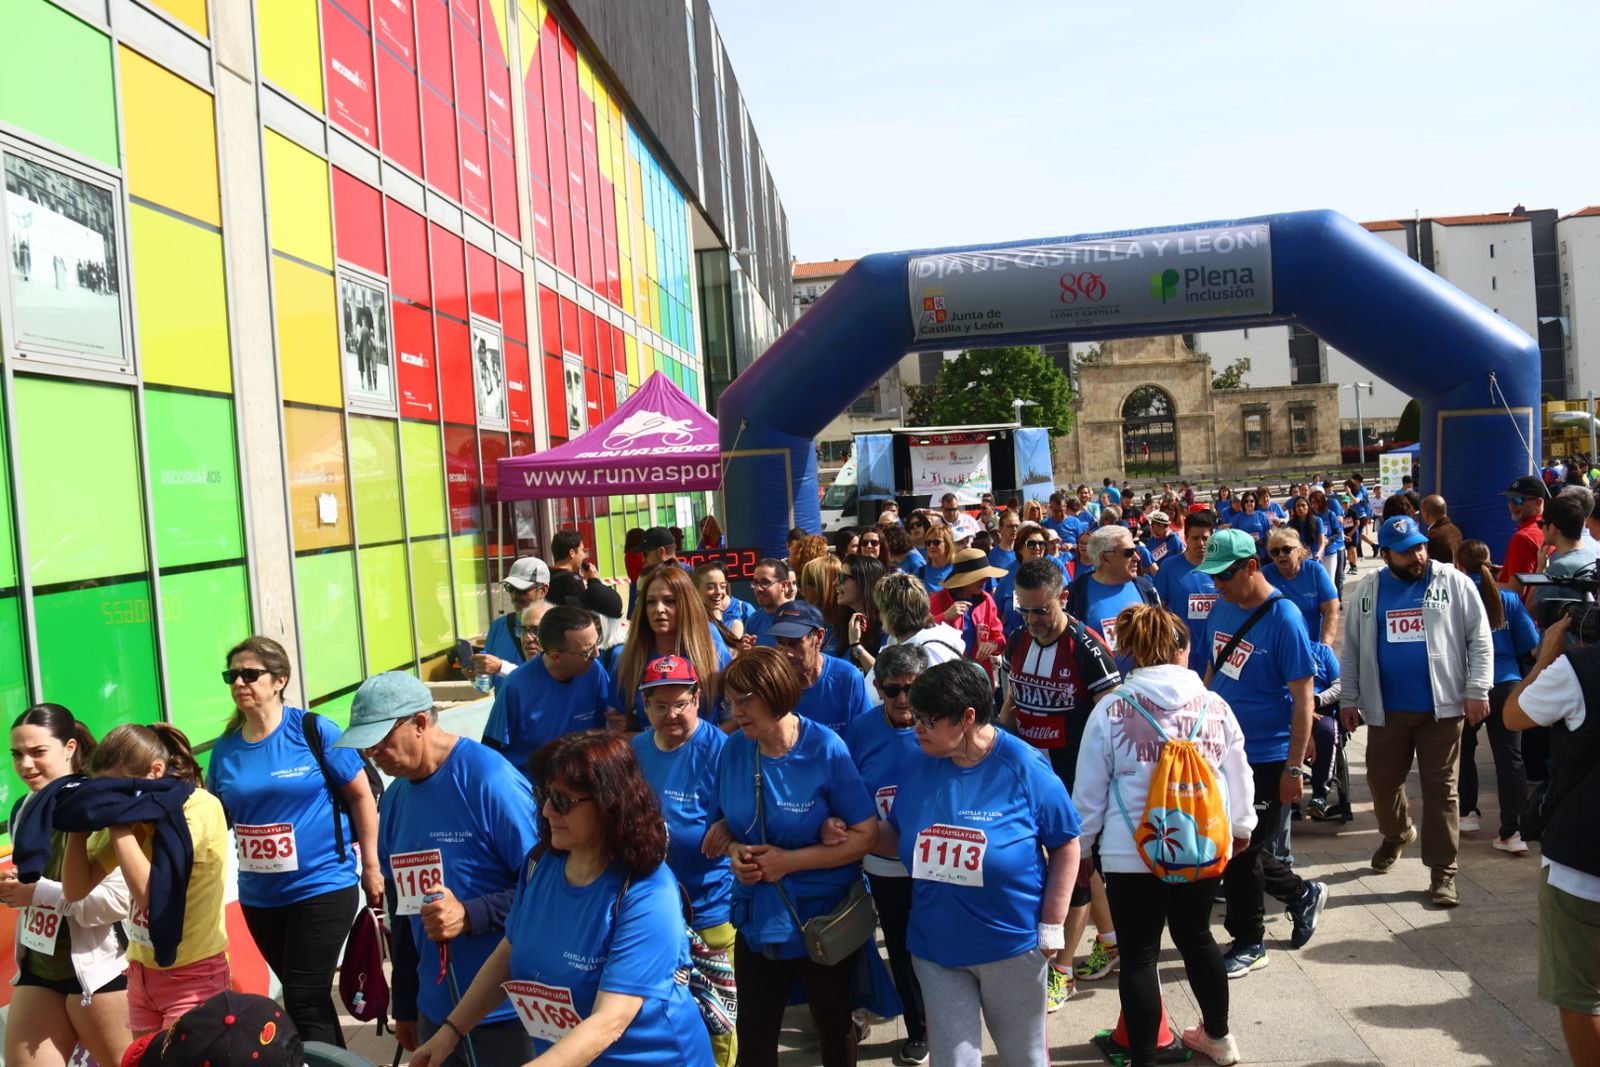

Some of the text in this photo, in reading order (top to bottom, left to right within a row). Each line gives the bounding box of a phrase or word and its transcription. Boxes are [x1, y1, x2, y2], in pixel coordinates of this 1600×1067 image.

[972, 254, 1008, 273] DE
[1015, 241, 1145, 269] CASTILLA
[1151, 238, 1170, 257] Y
[1178, 230, 1258, 255] LEÓN
[1184, 265, 1255, 288] Plena
[1184, 285, 1255, 303] inclusión
[951, 309, 1002, 321] Junta de
[921, 320, 1004, 334] Castilla y León
[1190, 601, 1212, 613] 109
[1389, 618, 1425, 634] 104
[1010, 671, 1070, 689] UNNING
[941, 829, 965, 838] CASTILLA
[240, 836, 293, 860] 1293
[919, 838, 982, 871] 1113
[396, 867, 443, 897] 1168
[23, 906, 59, 938] 1298
[516, 997, 583, 1030] 1169
